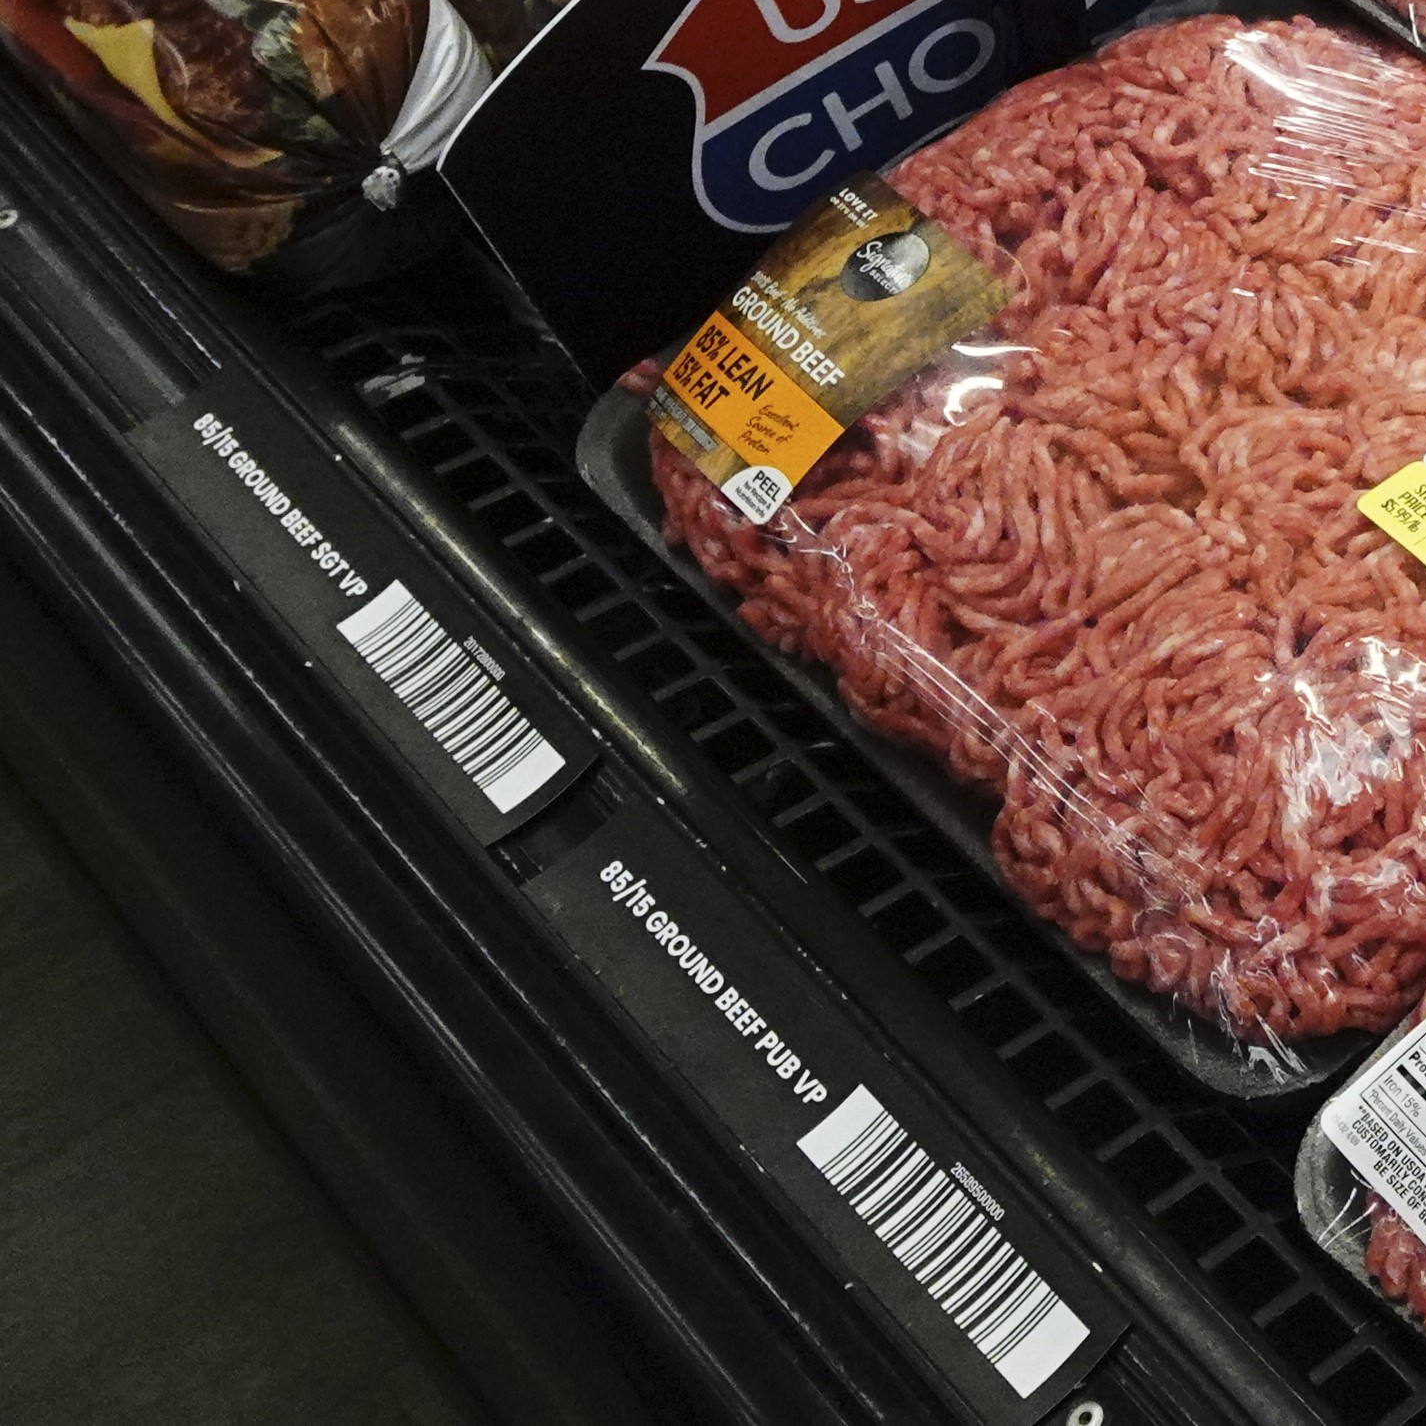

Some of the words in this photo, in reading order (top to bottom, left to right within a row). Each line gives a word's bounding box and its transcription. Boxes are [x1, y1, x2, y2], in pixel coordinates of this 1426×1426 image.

[673, 352, 702, 388] 15%
[688, 369, 730, 410] FAT
[696, 325, 730, 362] 85%
[717, 347, 774, 402] LEAN
[732, 286, 799, 350] GROUND
[790, 341, 845, 387] BEEF
[192, 413, 235, 458] 85/15
[228, 450, 291, 517] GROUND
[280, 506, 321, 550] BEEF
[311, 541, 348, 580] SGT
[338, 570, 368, 599] VP
[1380, 499, 1420, 534] $5.99/lb
[600, 860, 656, 918] 85/15
[645, 910, 723, 996] GROUND
[714, 986, 767, 1039] BEEF
[755, 1028, 800, 1080] PUB
[793, 1067, 827, 1106] VP
